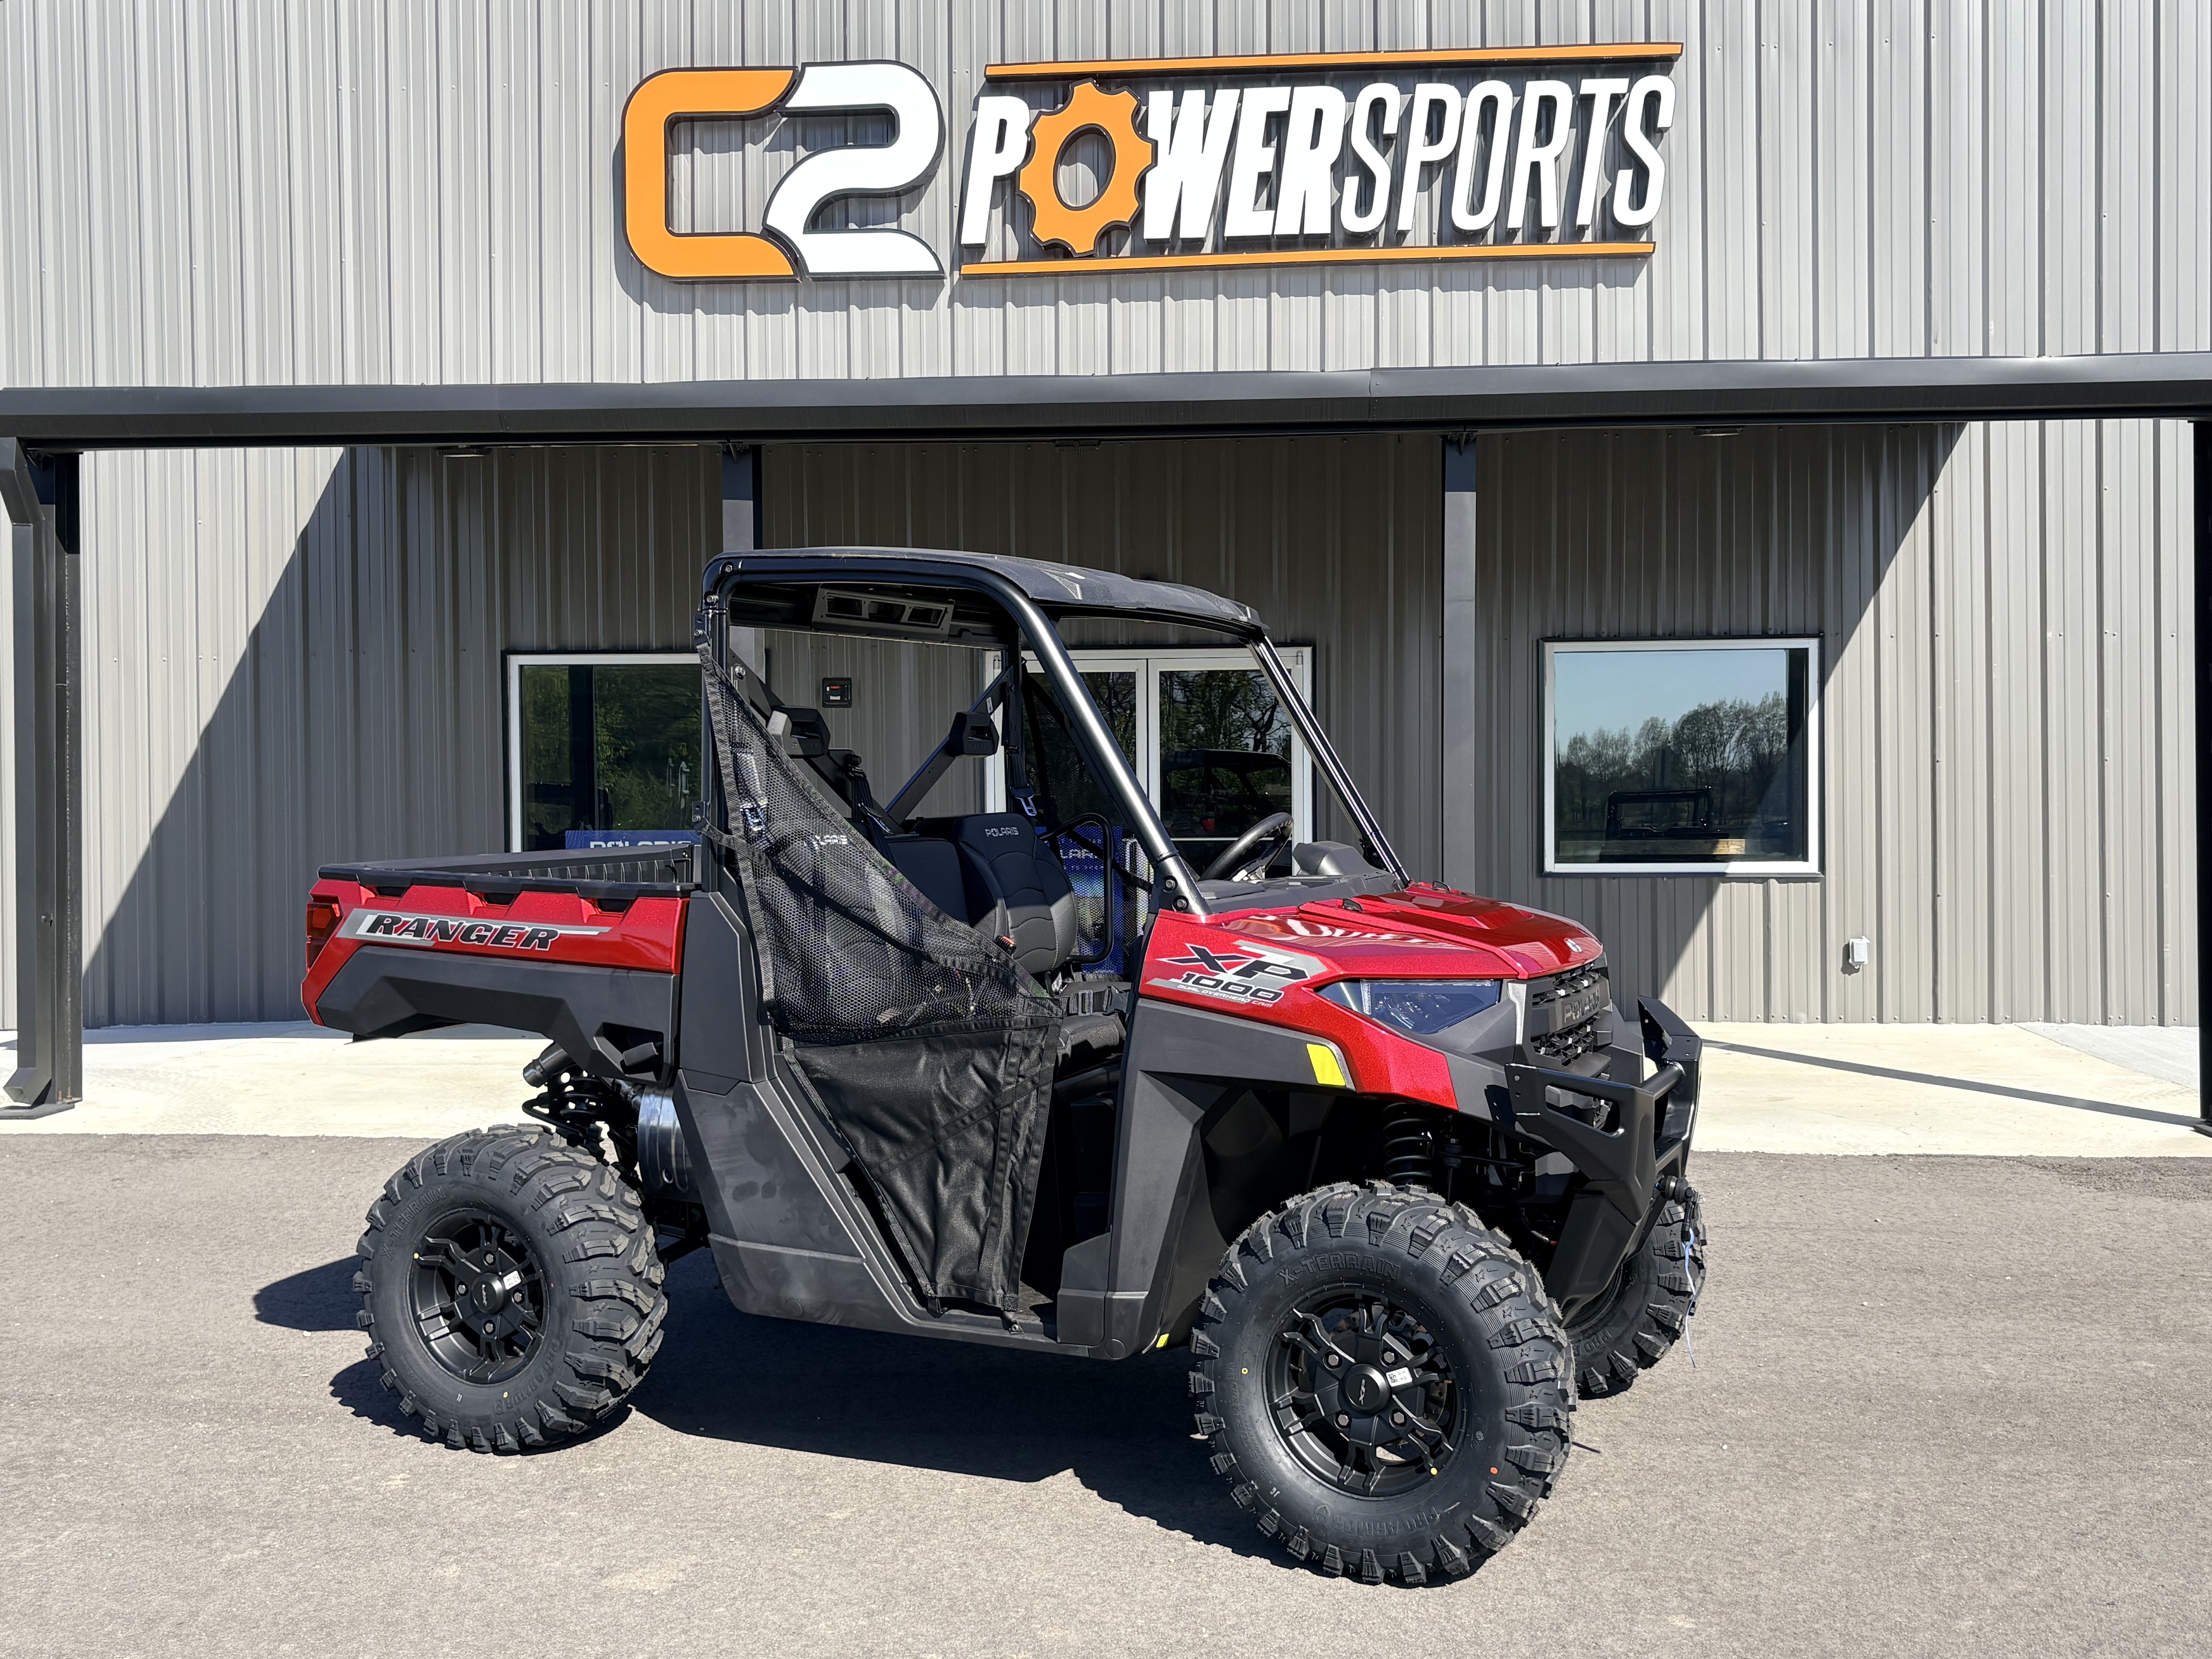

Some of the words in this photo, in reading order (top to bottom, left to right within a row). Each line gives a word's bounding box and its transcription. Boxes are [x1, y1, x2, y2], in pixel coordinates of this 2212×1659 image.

[622, 60, 946, 281] C2
[960, 75, 1675, 257] POWERSPORTS
[985, 827, 1019, 838] POLARIS
[366, 914, 561, 951] RANGER
[1155, 943, 1311, 982] XP
[1177, 984, 1200, 993] DUAL
[1201, 990, 1253, 1003] OVERHEAD
[1180, 971, 1285, 1003] 1000
[380, 1186, 446, 1261] X-TERRAIN
[1277, 1253, 1400, 1286] X-TERRAIN
